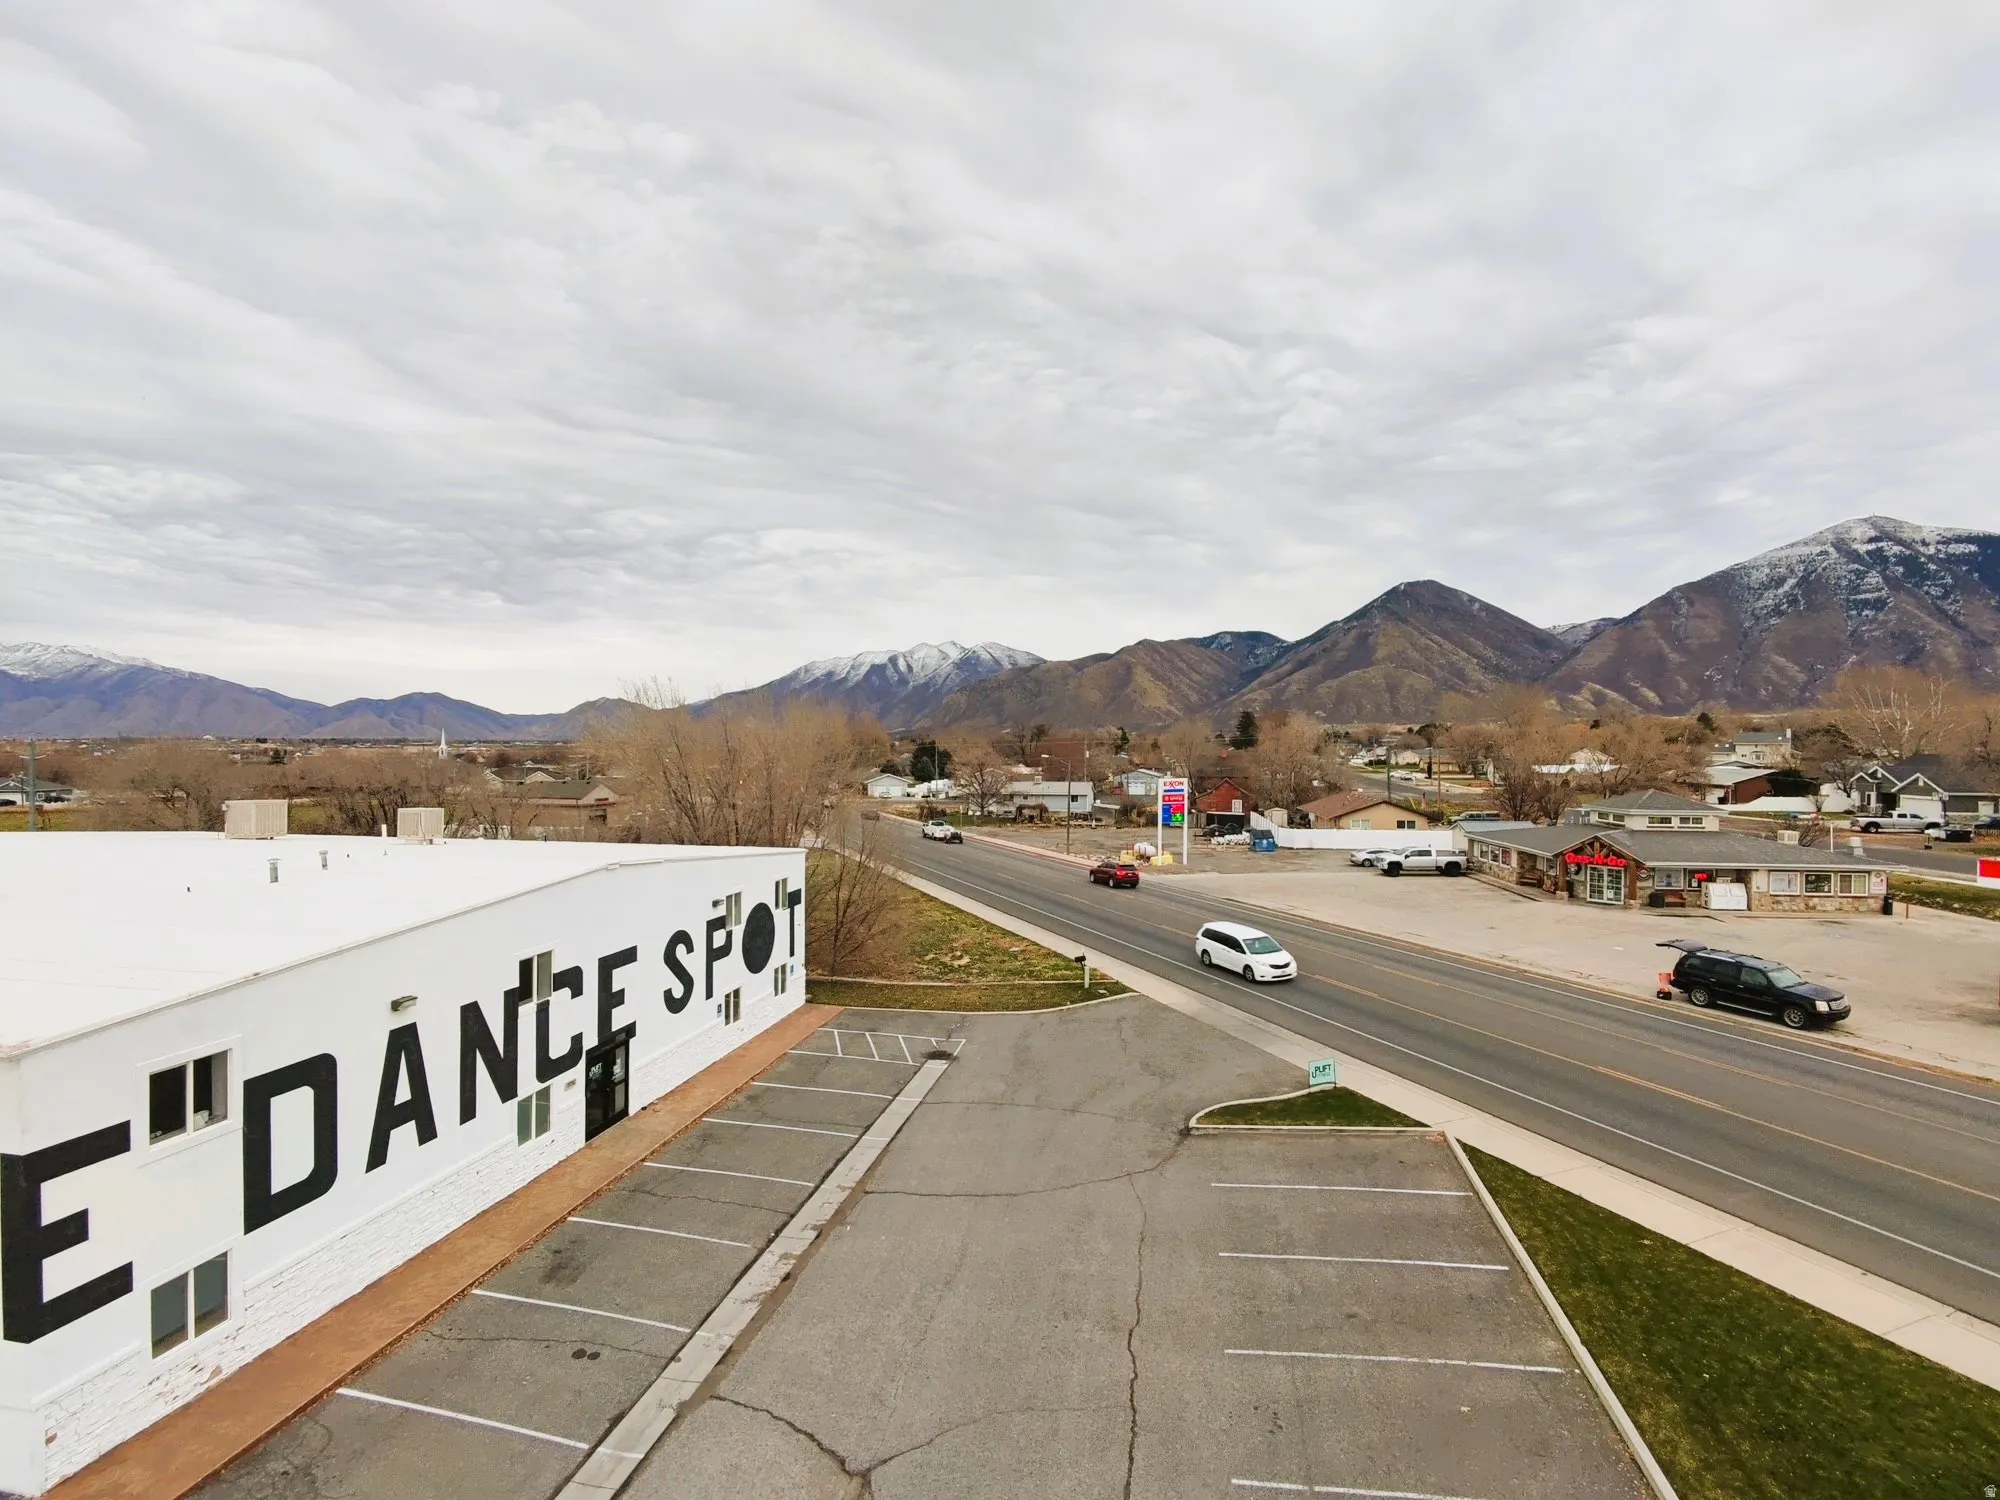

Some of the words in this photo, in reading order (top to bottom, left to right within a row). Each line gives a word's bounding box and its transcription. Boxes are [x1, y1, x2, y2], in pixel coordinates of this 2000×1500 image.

[243, 945, 638, 1235] DANCE
[662, 888, 802, 1015] SPOT
[1312, 1064, 1331, 1078] UPLIFT
